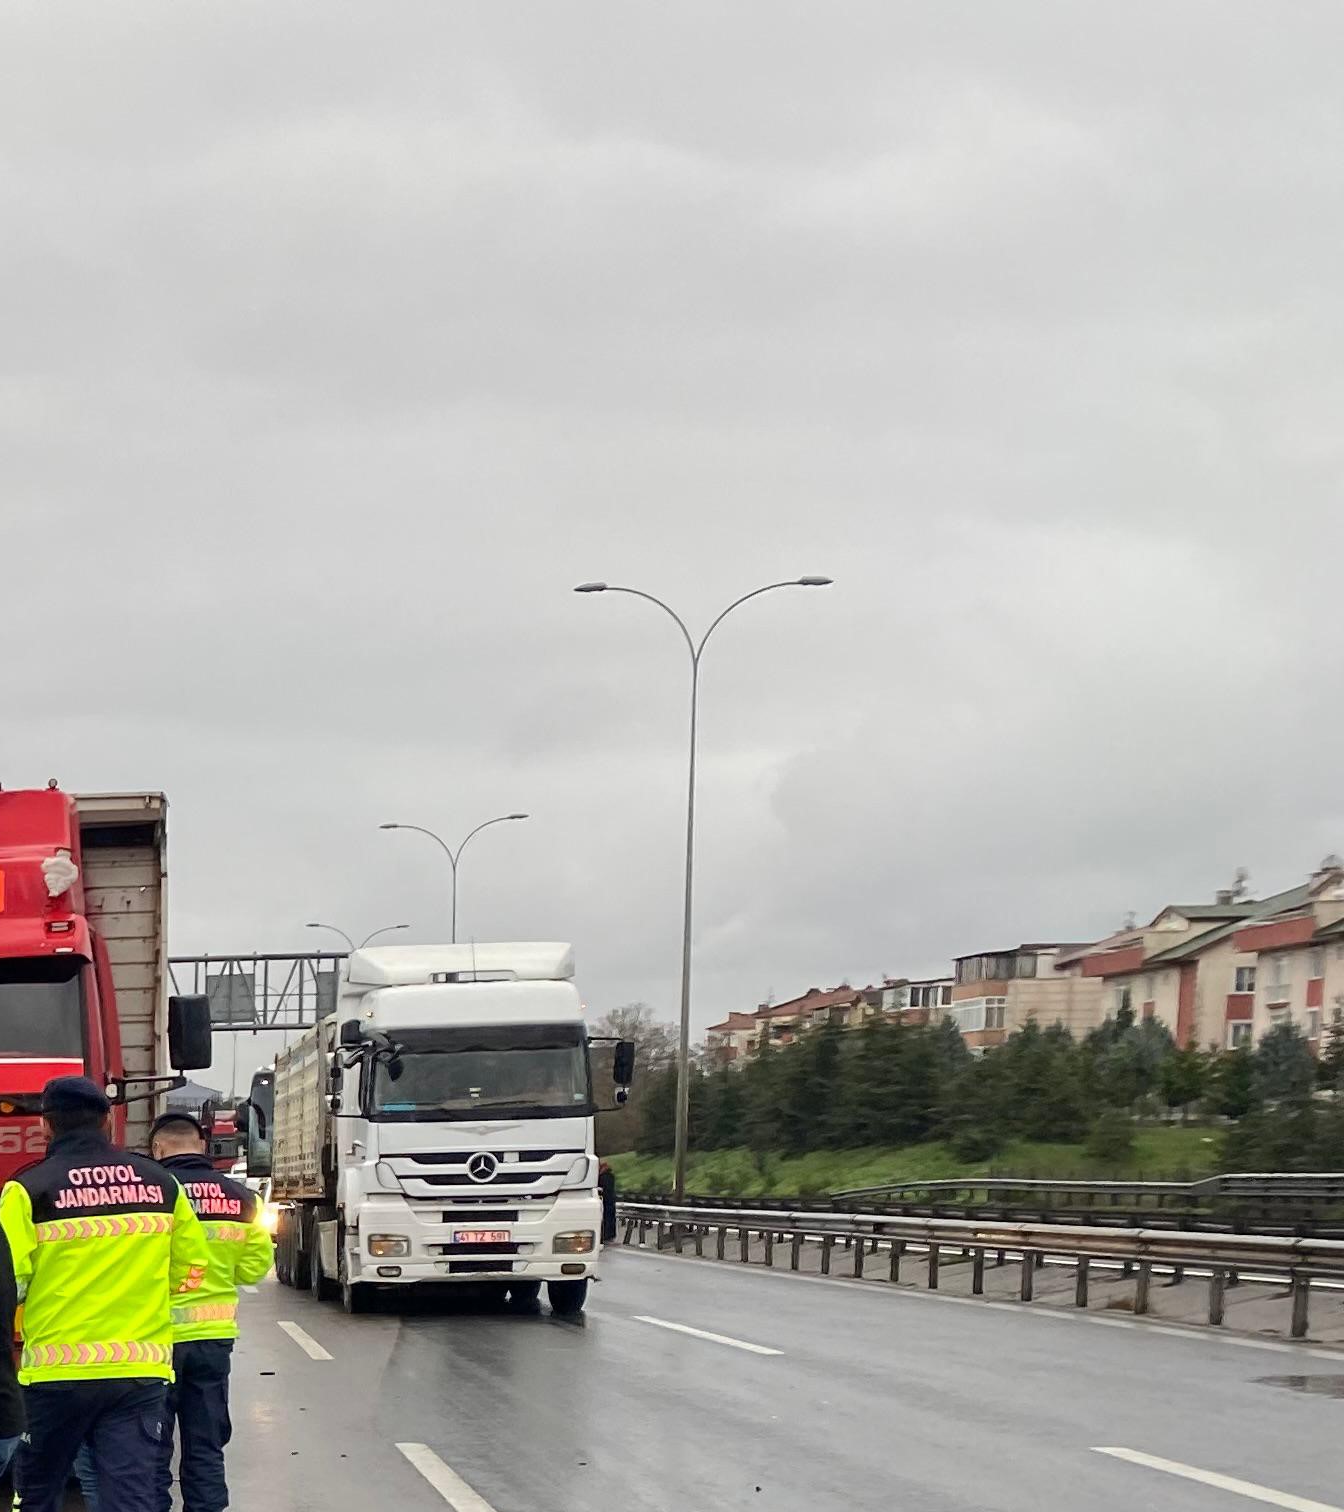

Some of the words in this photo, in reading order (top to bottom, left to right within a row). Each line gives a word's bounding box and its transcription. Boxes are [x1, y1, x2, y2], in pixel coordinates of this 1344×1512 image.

[68, 1165, 142, 1186] OTOYOL
[54, 1184, 164, 1209] JANDARMASI
[183, 1182, 226, 1199] TOYOL
